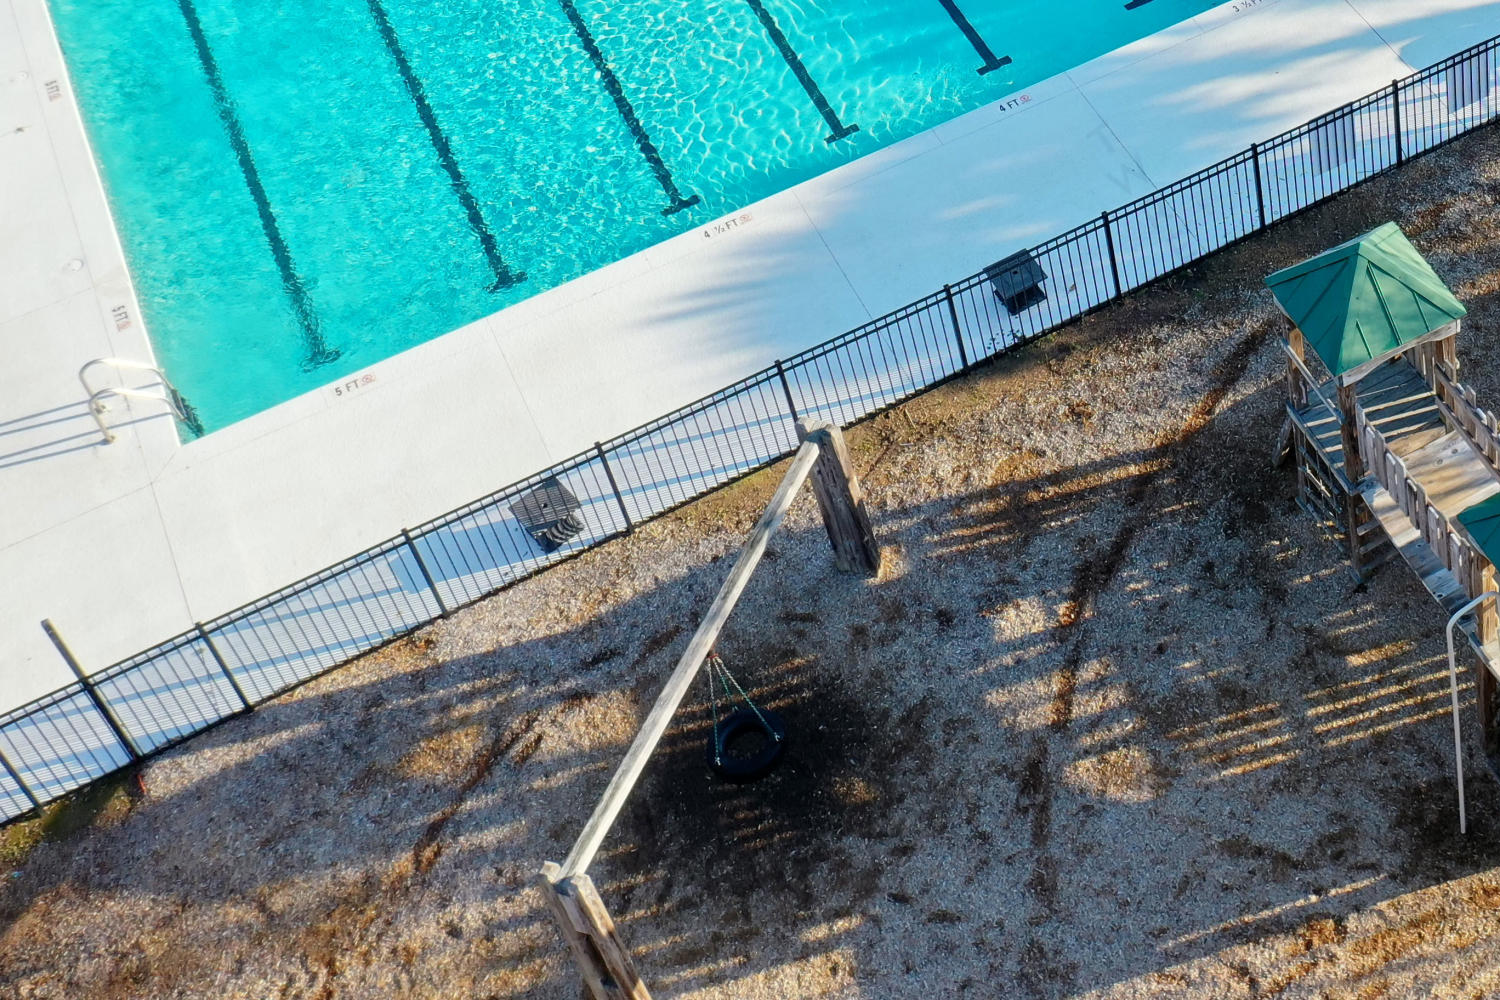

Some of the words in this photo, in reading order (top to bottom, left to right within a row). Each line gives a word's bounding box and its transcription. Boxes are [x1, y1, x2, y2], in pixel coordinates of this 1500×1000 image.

[1232, 5, 1240, 13] 3
[999, 104, 1006, 112] 4
[1007, 99, 1019, 109] FT
[704, 230, 711, 238] 4
[725, 218, 738, 230] FT
[113, 311, 129, 323] FT
[334, 387, 343, 396] 5
[345, 379, 359, 392] FT
